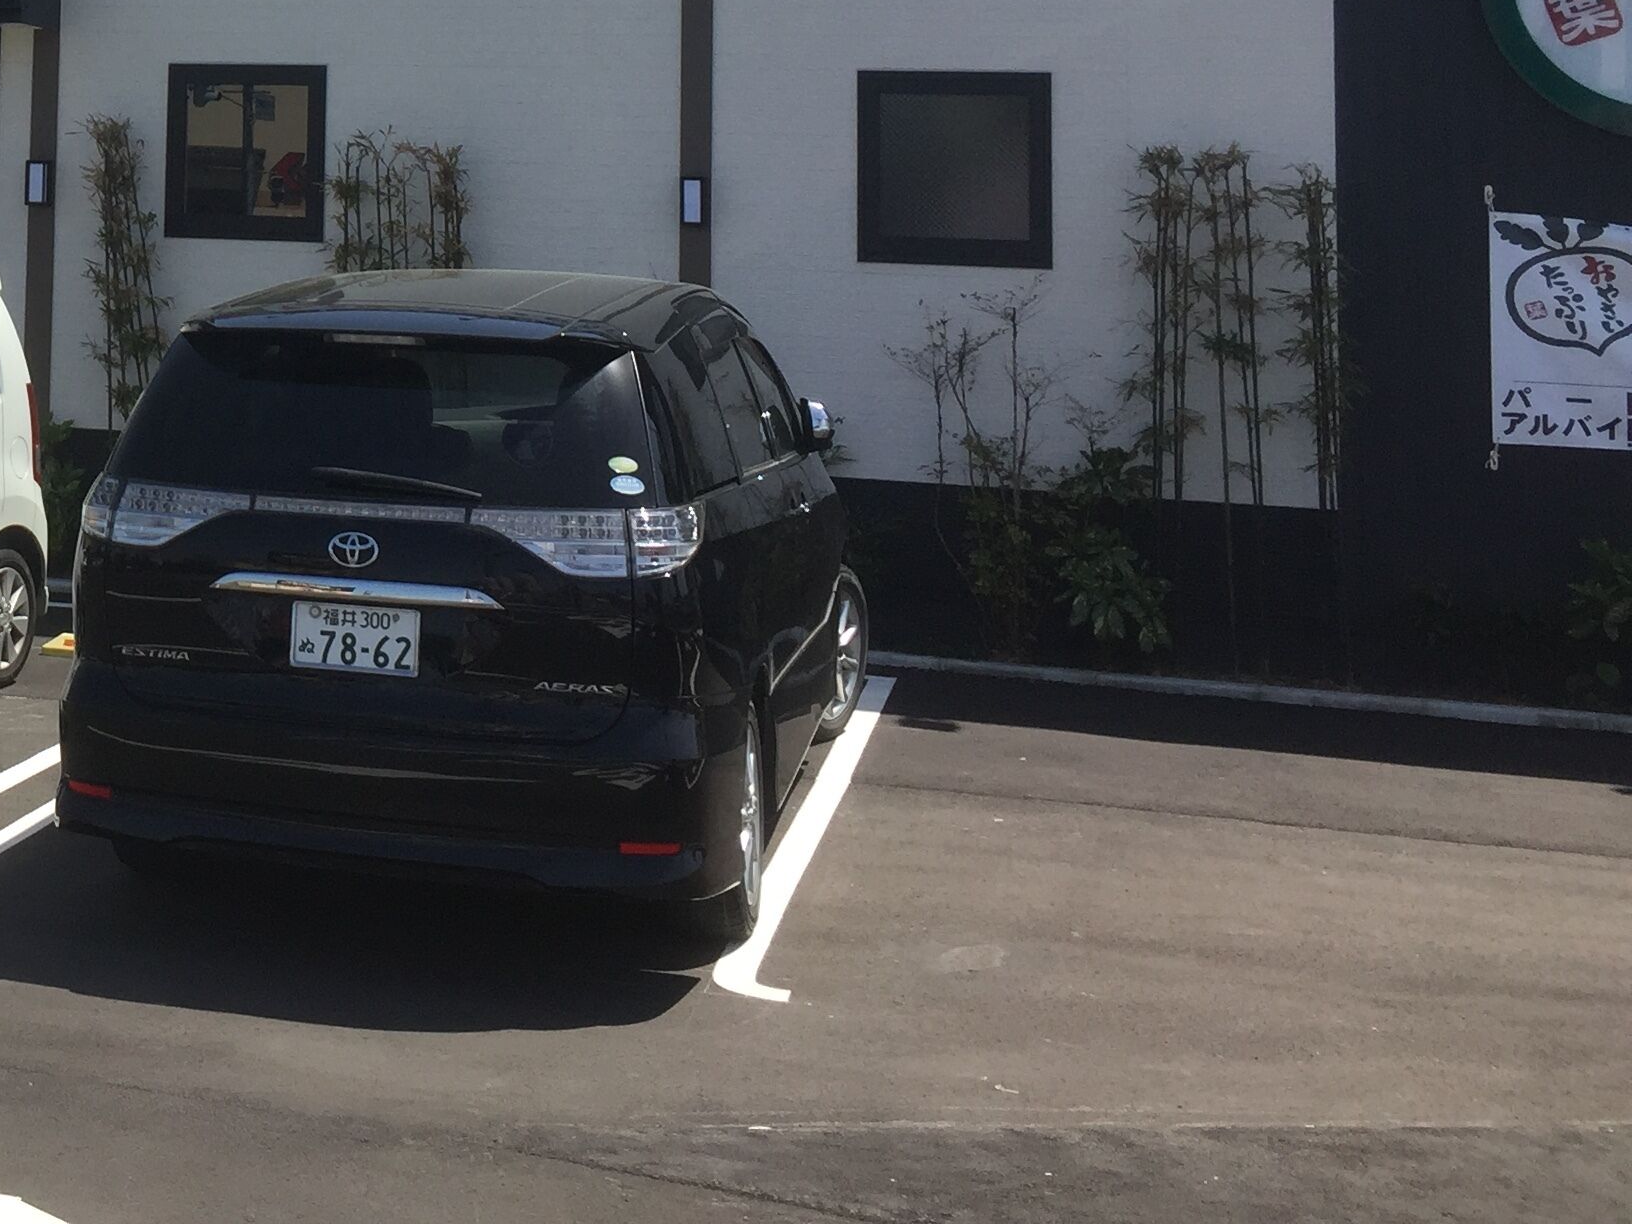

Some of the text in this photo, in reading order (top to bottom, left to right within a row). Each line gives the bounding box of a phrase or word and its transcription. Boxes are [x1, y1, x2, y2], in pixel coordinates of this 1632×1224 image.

[1539, 263, 1588, 340] たっぷり
[1579, 255, 1625, 333] おやさい
[121, 645, 190, 661] ESTIMA
[298, 629, 412, 670] ぬ 78-62
[533, 681, 627, 697] AERAS
